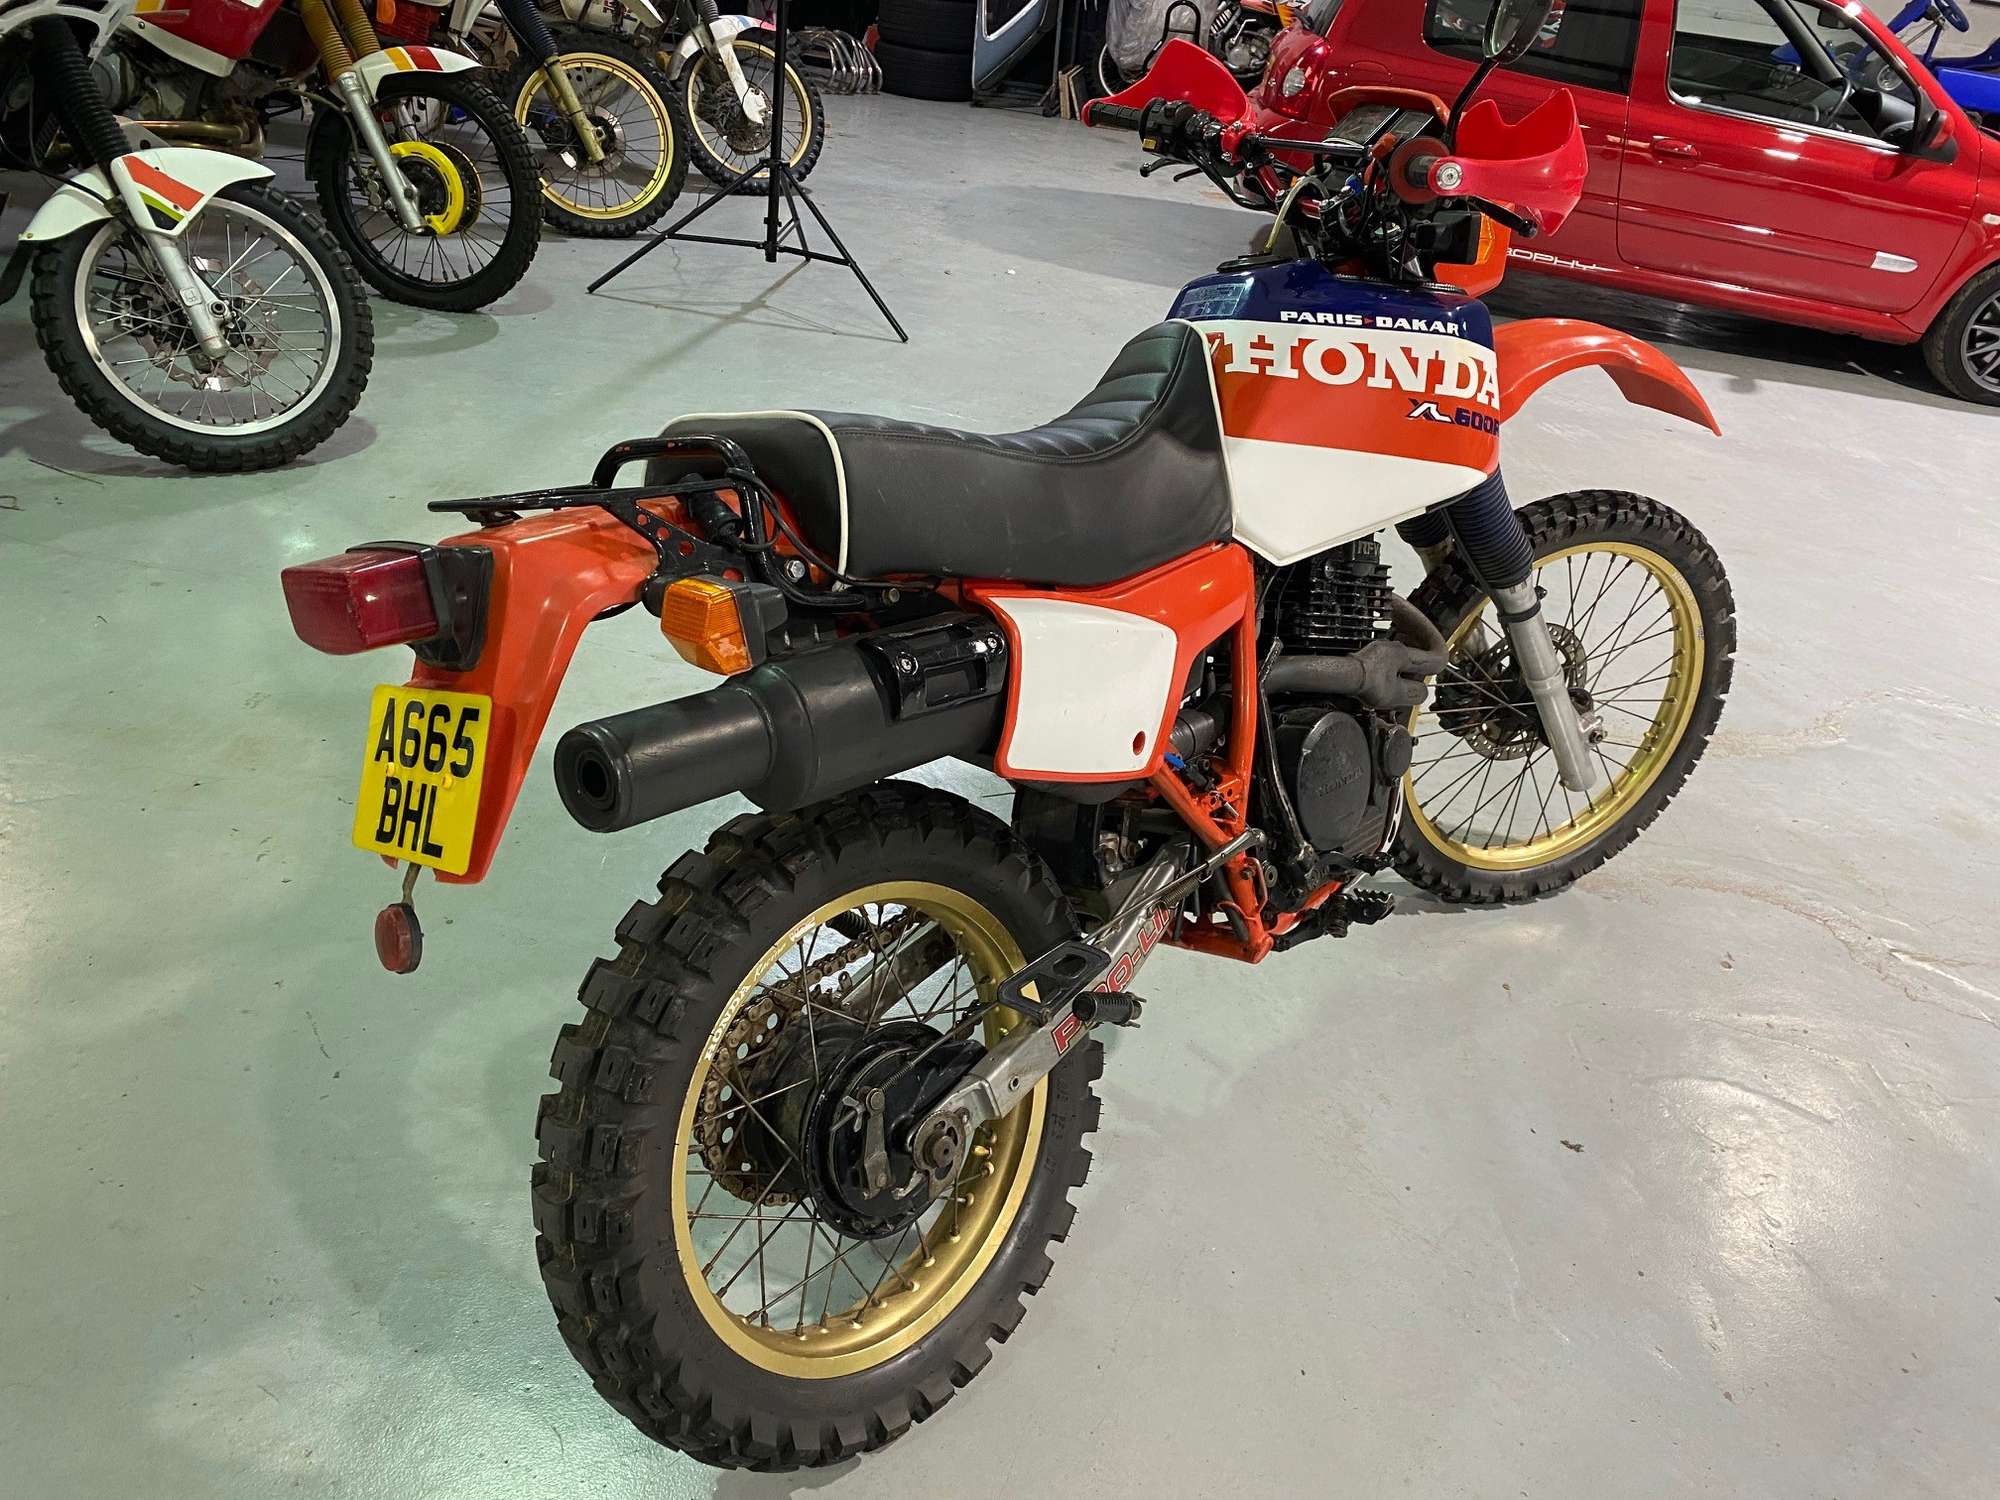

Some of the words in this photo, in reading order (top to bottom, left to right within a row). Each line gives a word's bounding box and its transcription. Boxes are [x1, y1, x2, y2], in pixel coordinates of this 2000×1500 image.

[1279, 310, 1363, 326] PARIS
[1375, 315, 1461, 337] DAKAR
[1223, 331, 1500, 410] HONDA
[1406, 397, 1455, 424] XL
[374, 697, 480, 779] A665
[374, 775, 444, 859] BHL
